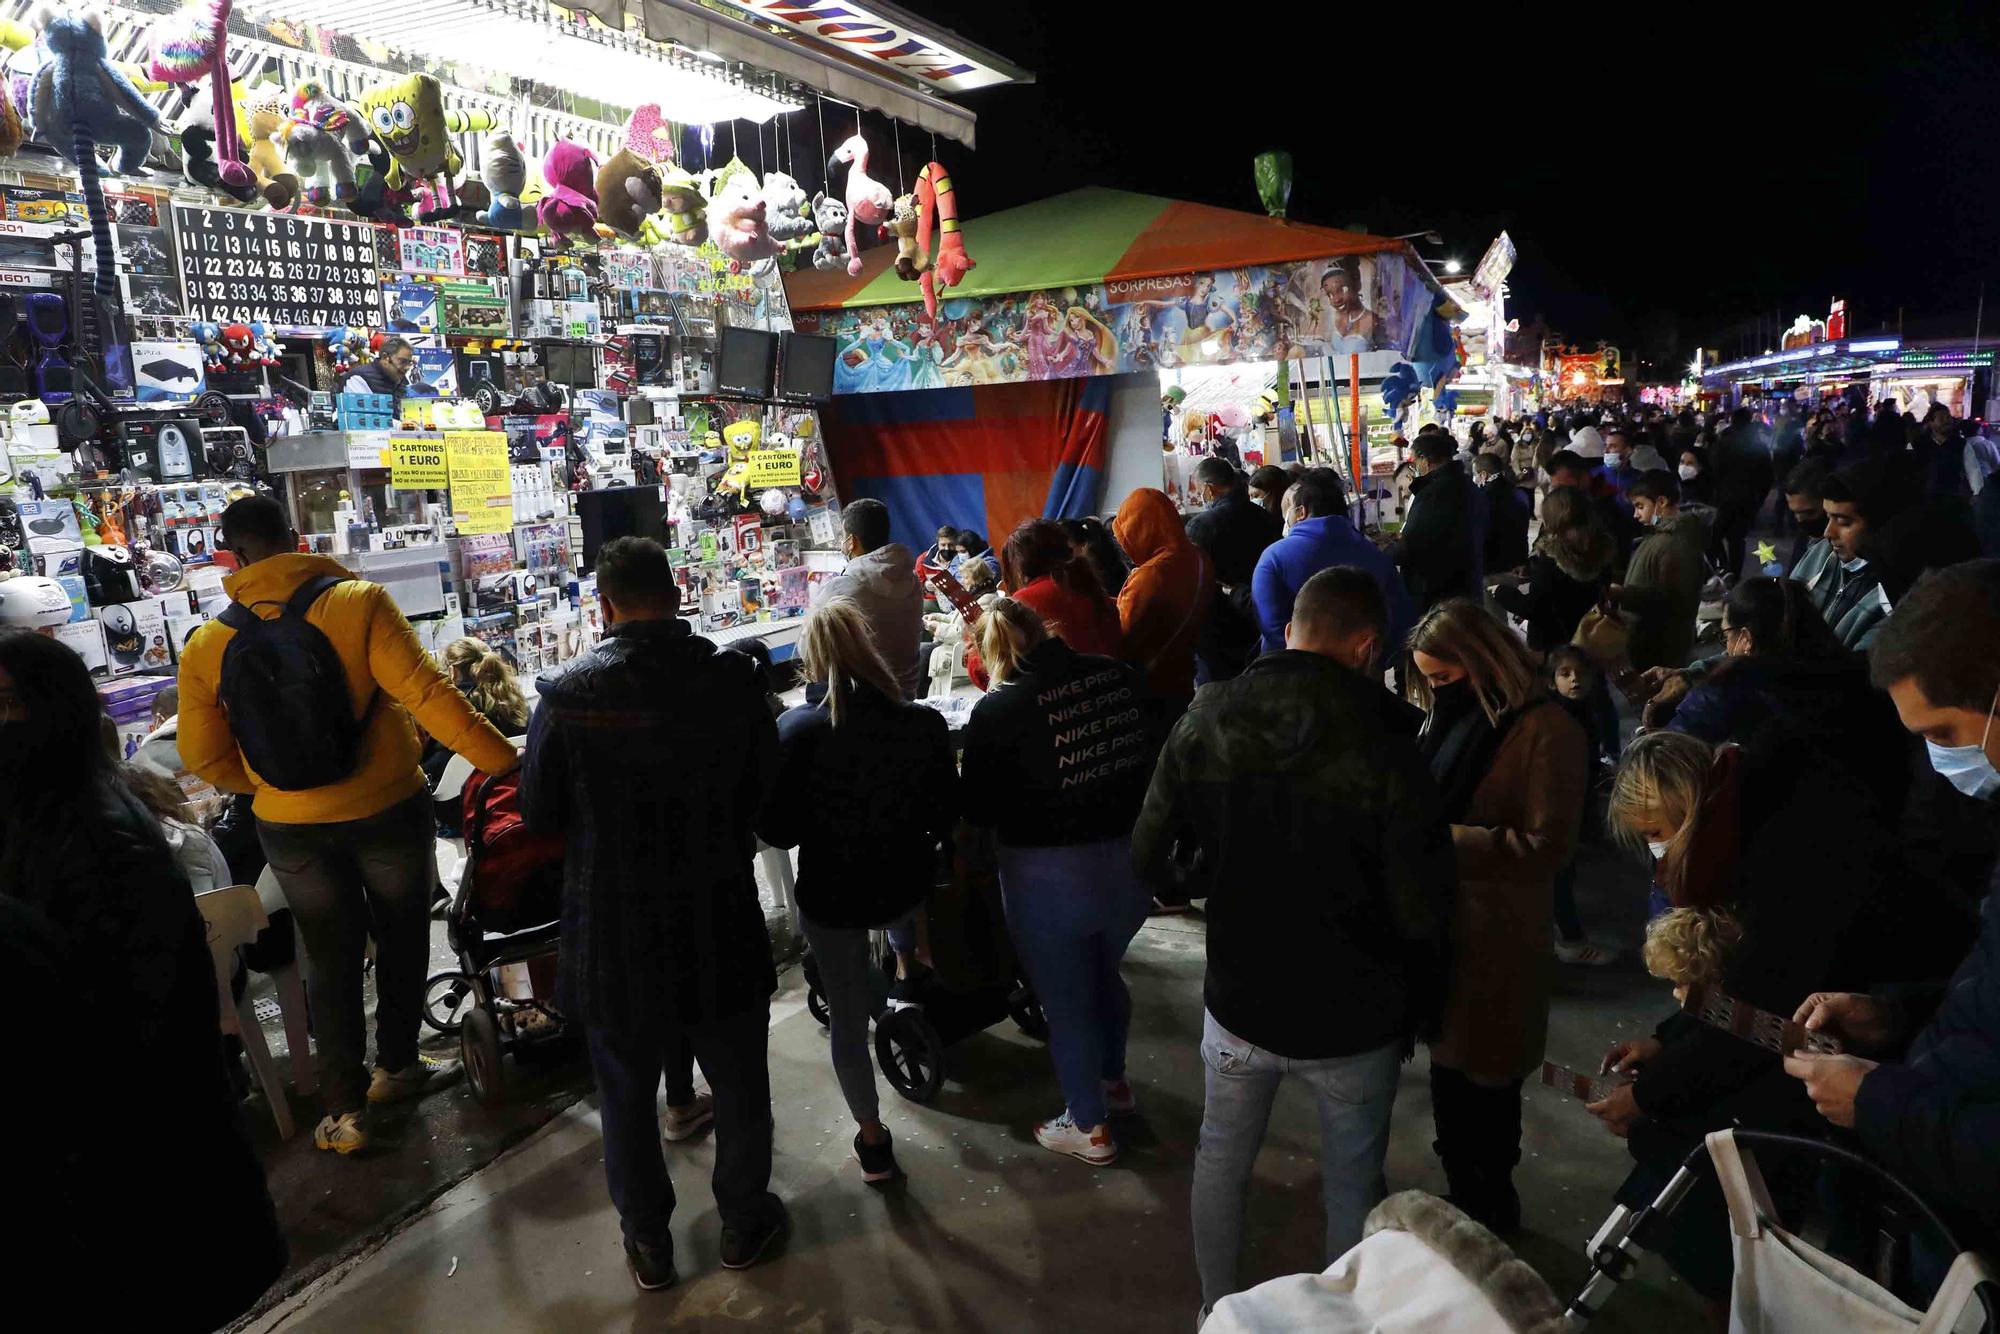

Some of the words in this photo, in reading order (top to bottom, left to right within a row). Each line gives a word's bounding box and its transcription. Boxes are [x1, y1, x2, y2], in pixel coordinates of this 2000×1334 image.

[184, 209, 189, 226] 1
[202, 210, 212, 228] 2
[226, 213, 234, 230] 3
[245, 215, 254, 232] 4
[267, 217, 275, 233] 5
[287, 220, 295, 235] 6
[304, 222, 312, 238] 7
[324, 223, 332, 239] 8
[342, 225, 350, 240] 9
[359, 227, 370, 243] 10
[183, 232, 196, 250] 11
[204, 234, 218, 251] 12
[225, 236, 240, 253] 13
[246, 238, 260, 255] 14
[265, 239, 280, 256] 15
[287, 241, 300, 258] 16
[306, 243, 318, 259] 17
[325, 244, 337, 261] 18
[343, 246, 354, 262] 19
[359, 247, 372, 263] 20
[185, 256, 200, 274] 21
[204, 258, 222, 276] 22
[226, 259, 244, 277] 23
[247, 260, 264, 278] 24
[268, 262, 284, 279] 25
[288, 263, 302, 280] 26
[308, 265, 320, 280] 27
[325, 266, 340, 282] 28
[344, 268, 359, 284] 29
[362, 269, 375, 285] 30
[188, 281, 203, 299] 31
[208, 282, 226, 299] 32
[230, 283, 247, 300] 33
[251, 285, 267, 301] 34
[271, 285, 287, 301] 35
[290, 286, 307, 303] 36
[310, 288, 324, 303] 37
[328, 289, 343, 304] 38
[347, 290, 361, 305] 39
[365, 289, 378, 305] 40
[1110, 275, 1192, 294] SORPRESAS
[191, 304, 206, 322] 41
[212, 306, 228, 323] 42
[233, 307, 250, 324] 43
[253, 307, 270, 323] 44
[274, 309, 290, 325] 45
[294, 310, 309, 325] 46
[313, 311, 327, 326] 47
[331, 310, 345, 326] 48
[349, 311, 363, 326] 49
[367, 311, 381, 326] 50
[400, 455, 404, 465] 1
[410, 456, 440, 465] EURO
[765, 462, 792, 470] EURO
[1037, 680, 1082, 706] NIKE
[1048, 700, 1093, 726] NIKE
[1096, 688, 1132, 710] PRO
[1055, 720, 1102, 748] NIKE
[1106, 708, 1139, 729] PRO
[1059, 742, 1108, 768] NIKE
[1112, 729, 1144, 750] PRO
[1062, 762, 1112, 789] NIKE
